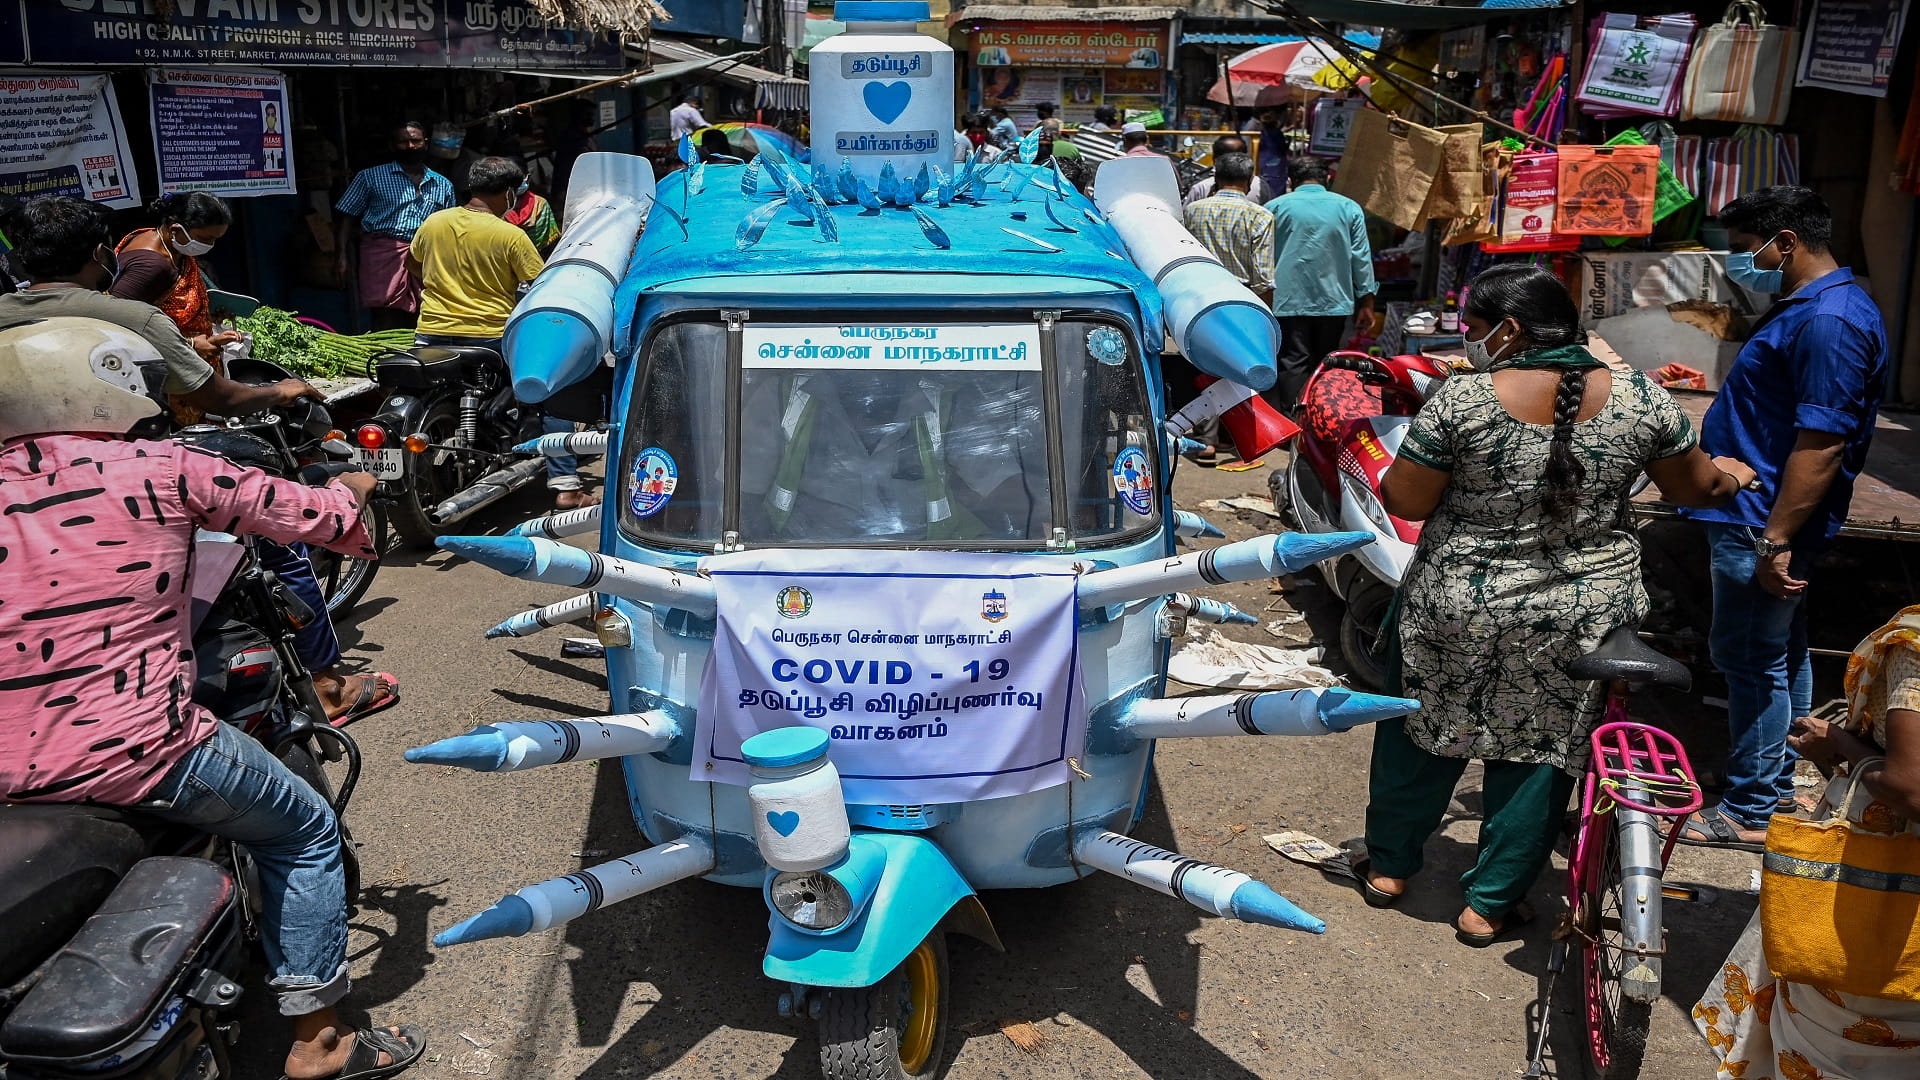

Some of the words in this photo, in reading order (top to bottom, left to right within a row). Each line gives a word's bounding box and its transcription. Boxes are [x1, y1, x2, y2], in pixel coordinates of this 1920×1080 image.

[94, 21, 141, 40] HIGH
[224, 27, 301, 45] PROVISION
[305, 33, 312, 46] &
[315, 31, 344, 46] RICE
[349, 33, 416, 49] MERCHANTS
[1087, 31, 1158, 48] ஸ்டோர்
[500, 37, 543, 53] தேங்காய்
[144, 49, 159, 59] 92,
[162, 49, 195, 59] N.M.K.
[239, 50, 278, 61] MARKET,
[279, 51, 334, 62] AYANAVARAM,
[335, 52, 367, 62] CHENNAI
[373, 54, 385, 62] 600
[851, 54, 921, 76] தடுப்பூசி
[38, 77, 80, 92] அறிவிப்பு
[168, 71, 212, 84] சென்னை
[213, 73, 252, 86] பெருநகர
[253, 76, 280, 87] காவல்
[263, 136, 281, 144] PLEASE
[836, 132, 938, 152] உயிர்காக்கும்
[83, 156, 114, 165] PLEASE
[838, 326, 938, 340] பெருநகர
[758, 338, 872, 360] சென்னை
[884, 340, 1028, 365] மாநகராட்சி
[361, 449, 375, 460] TN
[377, 450, 389, 461] 01
[372, 462, 397, 473] 4840
[772, 628, 842, 648] பெருநகர
[847, 629, 919, 645] சென்னை
[924, 629, 1012, 649] மாநகராட்சி
[771, 658, 913, 686] COVID
[930, 672, 944, 680] -
[962, 658, 1011, 685] 19
[738, 687, 854, 719] தடுப்பூசி
[865, 685, 1043, 721] விழிப்புணர்வு
[830, 716, 948, 742] வாகனம்
